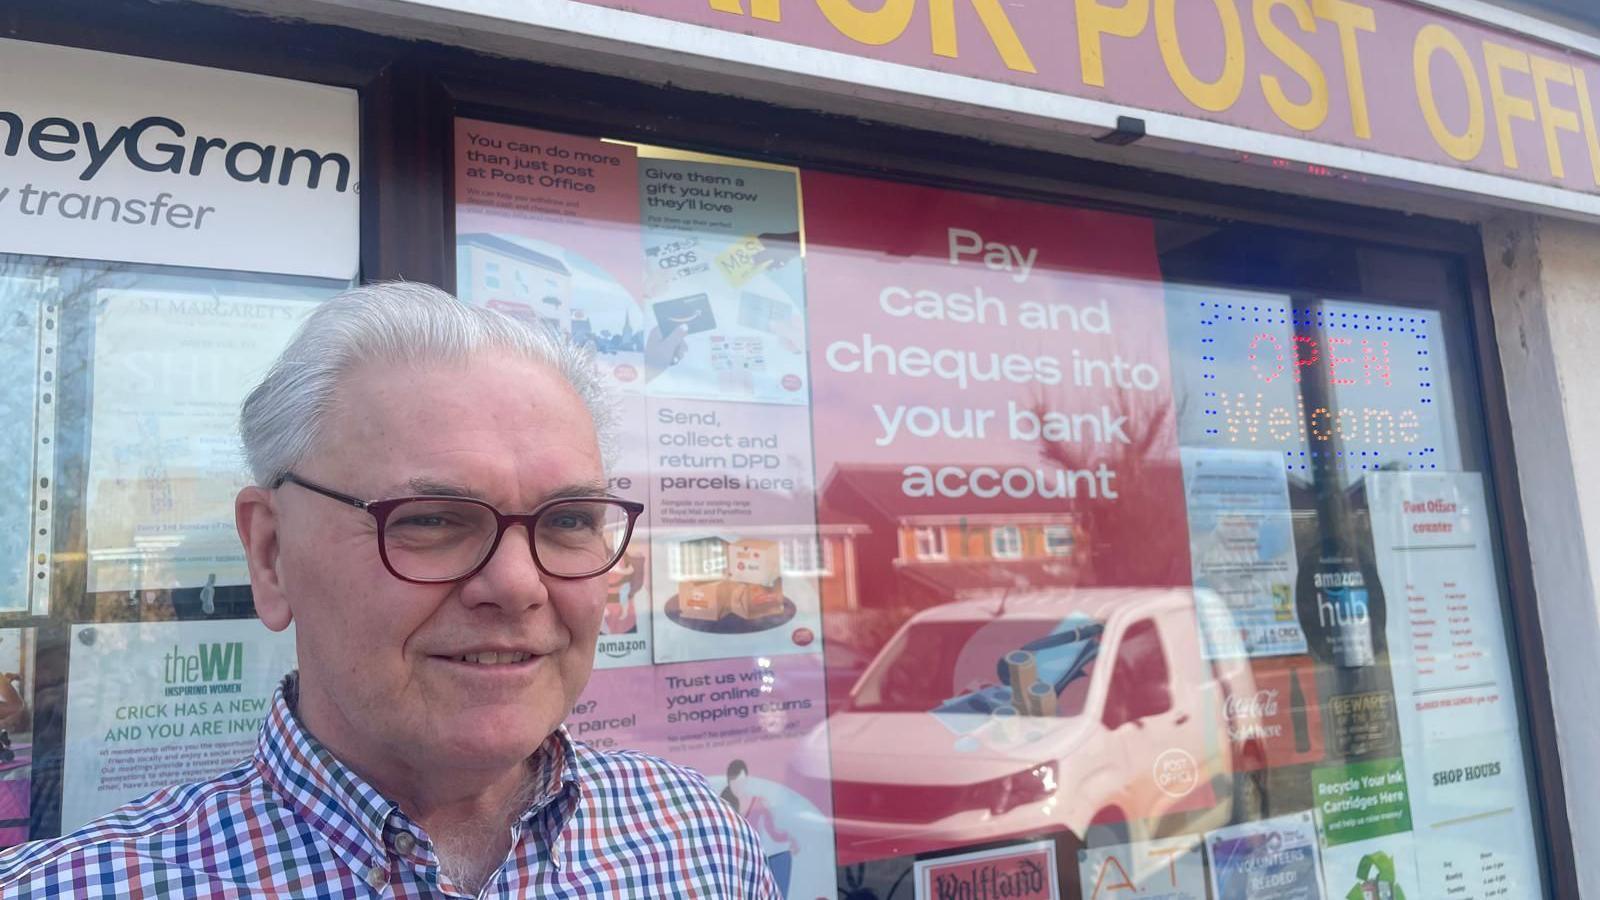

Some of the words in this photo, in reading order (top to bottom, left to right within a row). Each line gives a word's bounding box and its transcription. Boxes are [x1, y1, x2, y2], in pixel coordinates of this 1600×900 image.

[1079, 0, 1377, 140] POST
[466, 132, 502, 150] You
[507, 140, 541, 155] can
[547, 145, 570, 160] do
[574, 152, 621, 167] more
[466, 150, 510, 166] than
[514, 157, 549, 177] just
[553, 162, 595, 180] post
[466, 165, 486, 179] at
[490, 168, 535, 188] Post
[542, 174, 596, 194] Office
[646, 168, 684, 183] Give
[689, 171, 732, 186] them
[736, 176, 745, 187] a
[648, 182, 677, 200] gift
[682, 187, 711, 203] you
[715, 188, 758, 203] know
[648, 194, 694, 212] they'll
[698, 199, 734, 214] love
[19, 183, 215, 230] transfer
[946, 226, 1037, 283] Pay
[879, 285, 1007, 327] cash
[1018, 300, 1110, 336] and
[825, 333, 1062, 391] cheques
[1071, 349, 1159, 392] into
[1248, 332, 1394, 388] OPEN
[659, 407, 721, 429] Send,
[873, 401, 995, 448] your
[1008, 401, 1129, 445] bank
[1220, 392, 1421, 444] Welcome
[659, 430, 733, 453] collect
[738, 431, 778, 452] and
[659, 453, 727, 473] return
[732, 452, 780, 473] DPD
[661, 473, 741, 494] parcels
[746, 473, 794, 491] here
[901, 462, 1118, 500] account
[1402, 500, 1426, 514] Post
[1427, 498, 1457, 513] Office
[1313, 571, 1365, 589] amazon
[1317, 592, 1370, 628] hub
[598, 639, 647, 655] amazon
[164, 683, 208, 697] INSPIRING
[209, 682, 242, 696] WOMEN
[665, 673, 710, 691] Trust
[716, 670, 737, 685] us
[666, 690, 704, 709] your
[710, 685, 761, 703] online
[115, 703, 168, 721] CRICK
[175, 700, 208, 718] HAS
[213, 701, 224, 715] A
[229, 698, 267, 714] NEW
[666, 702, 749, 724] shopping
[104, 724, 143, 742] AND
[147, 722, 185, 740] YOU
[189, 720, 224, 737] ARE
[579, 713, 636, 735] parcel
[1318, 777, 1360, 797] Recycle
[1361, 775, 1385, 789] Your
[1387, 770, 1404, 784] Ink
[1432, 769, 1463, 787] SHOP
[1465, 761, 1502, 782] HOURS
[1323, 795, 1377, 814] Cartridges
[1379, 790, 1405, 804] Here
